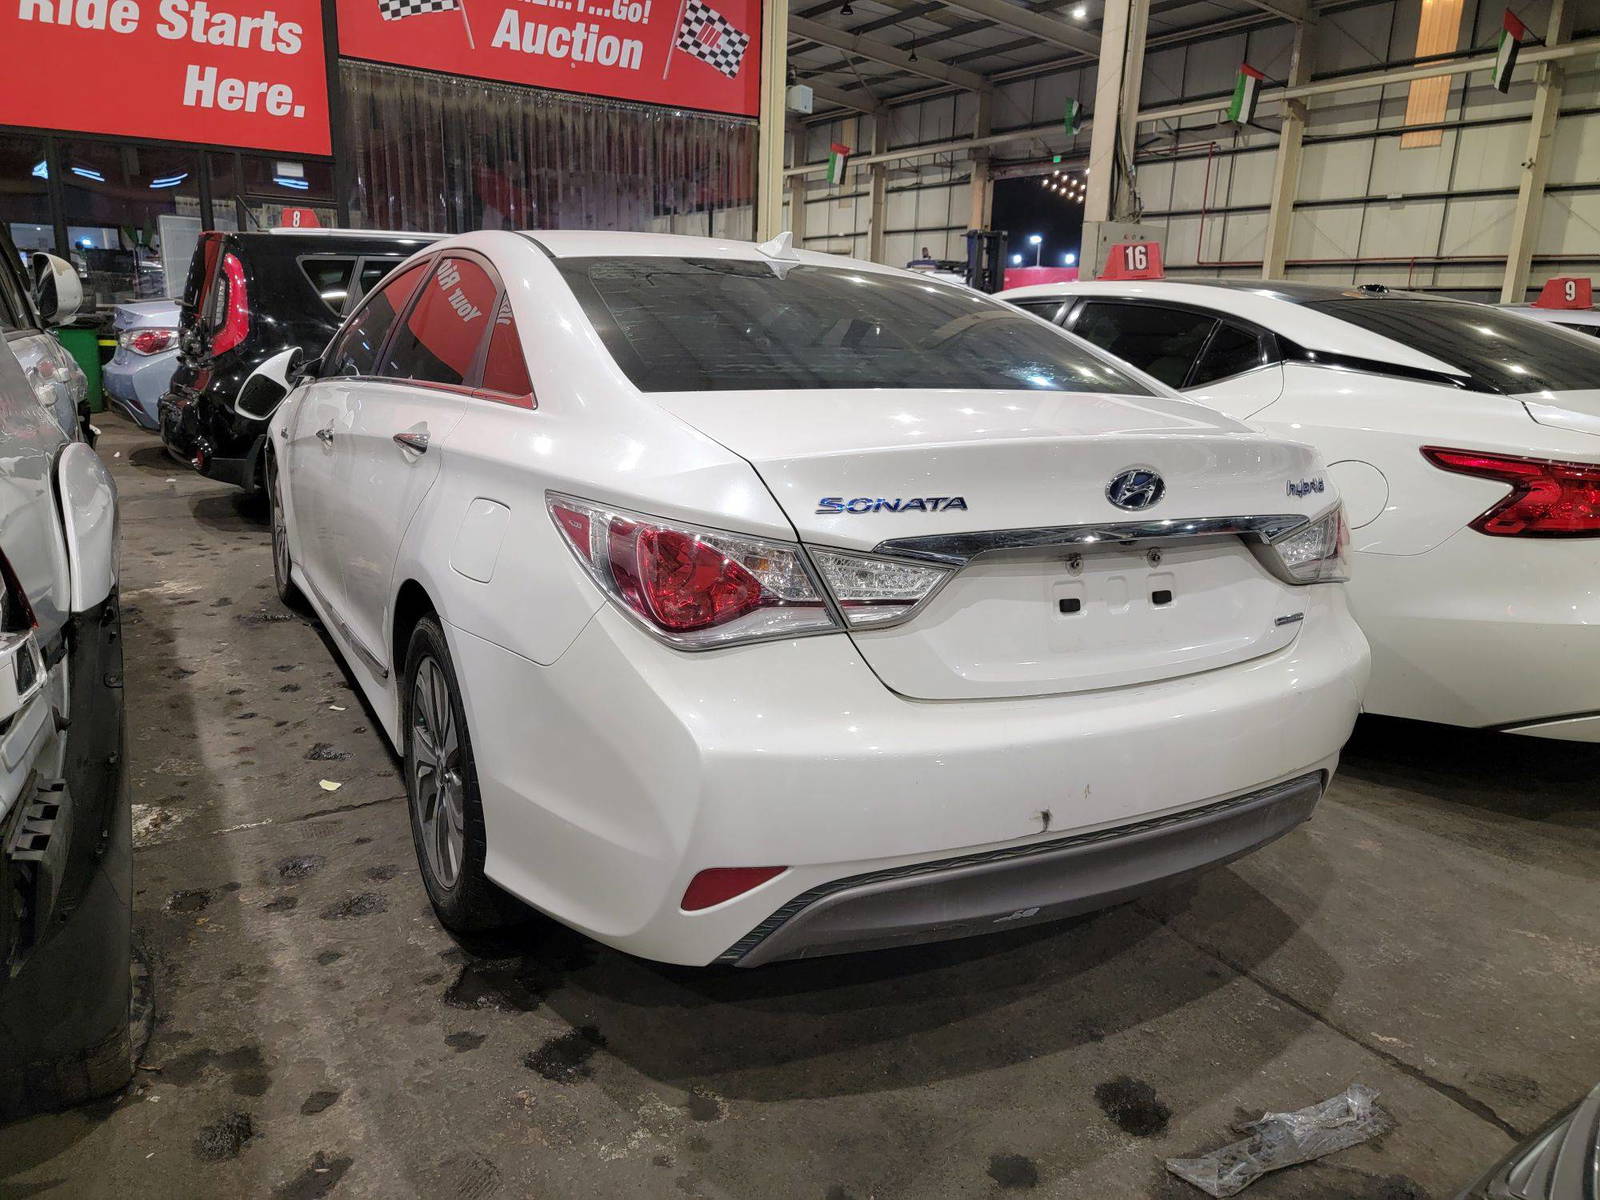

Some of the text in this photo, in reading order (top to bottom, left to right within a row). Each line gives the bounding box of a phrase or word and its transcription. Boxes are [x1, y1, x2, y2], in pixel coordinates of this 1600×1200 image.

[156, 0, 303, 55] Starts
[490, 8, 644, 70] Auction
[183, 64, 306, 118] Here.
[292, 210, 301, 228] 8
[1125, 245, 1147, 270] 16
[1565, 280, 1576, 301] 9
[815, 496, 969, 515] SONATA
